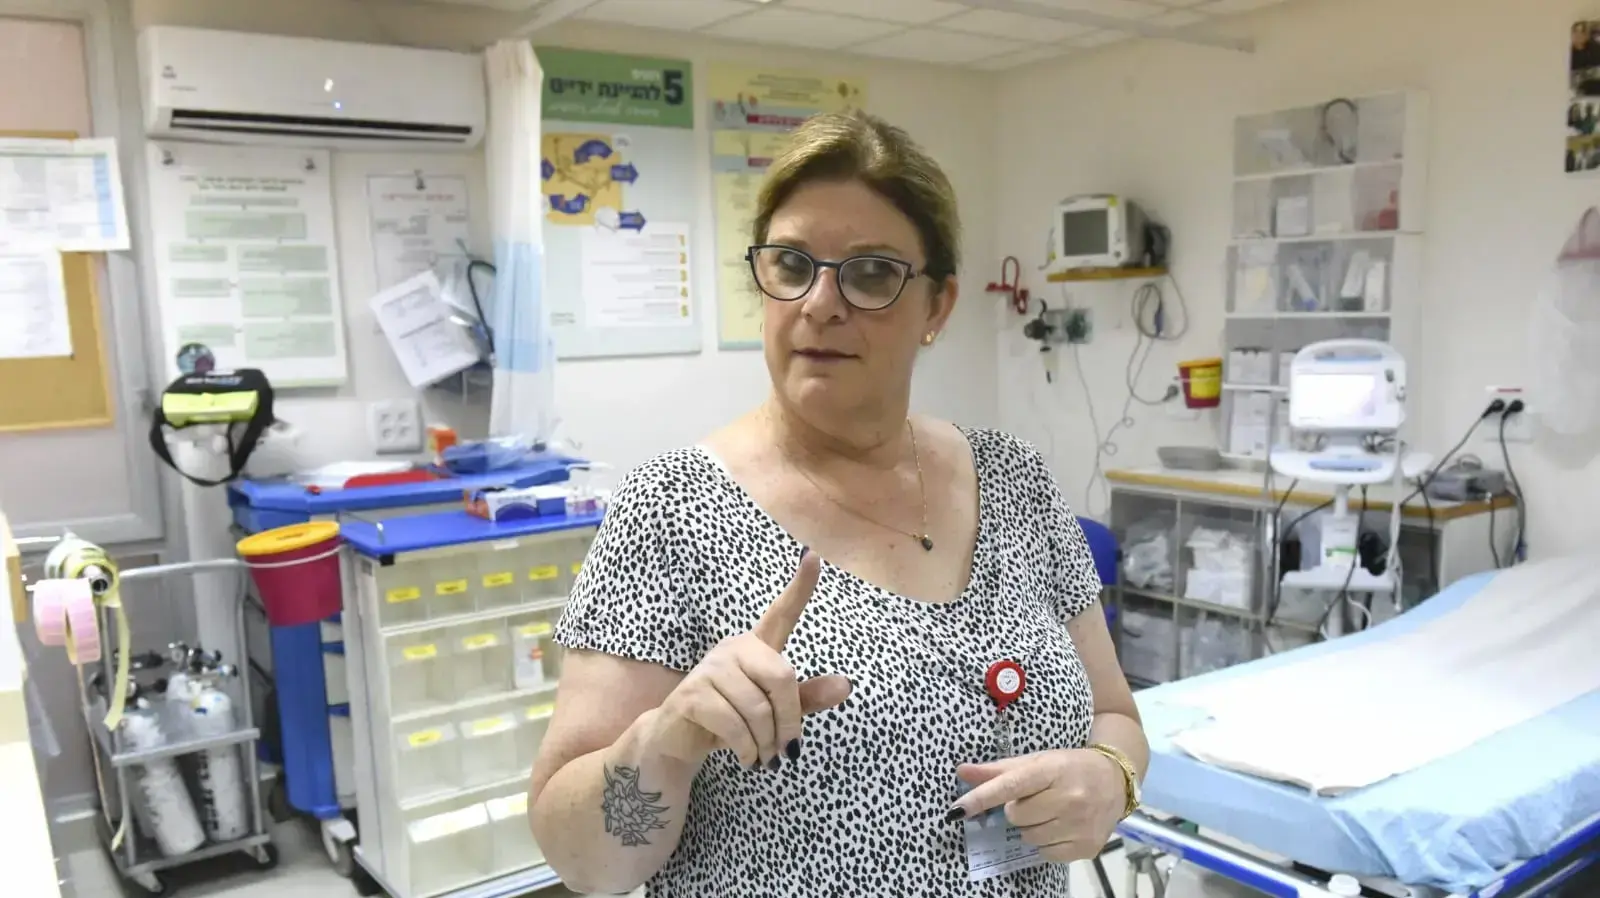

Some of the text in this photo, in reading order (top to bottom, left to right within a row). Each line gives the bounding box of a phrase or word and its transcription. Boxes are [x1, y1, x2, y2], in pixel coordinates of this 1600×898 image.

[549, 77, 594, 96] ידיים
[598, 81, 662, 101] להגיינת
[663, 69, 684, 105] 5
